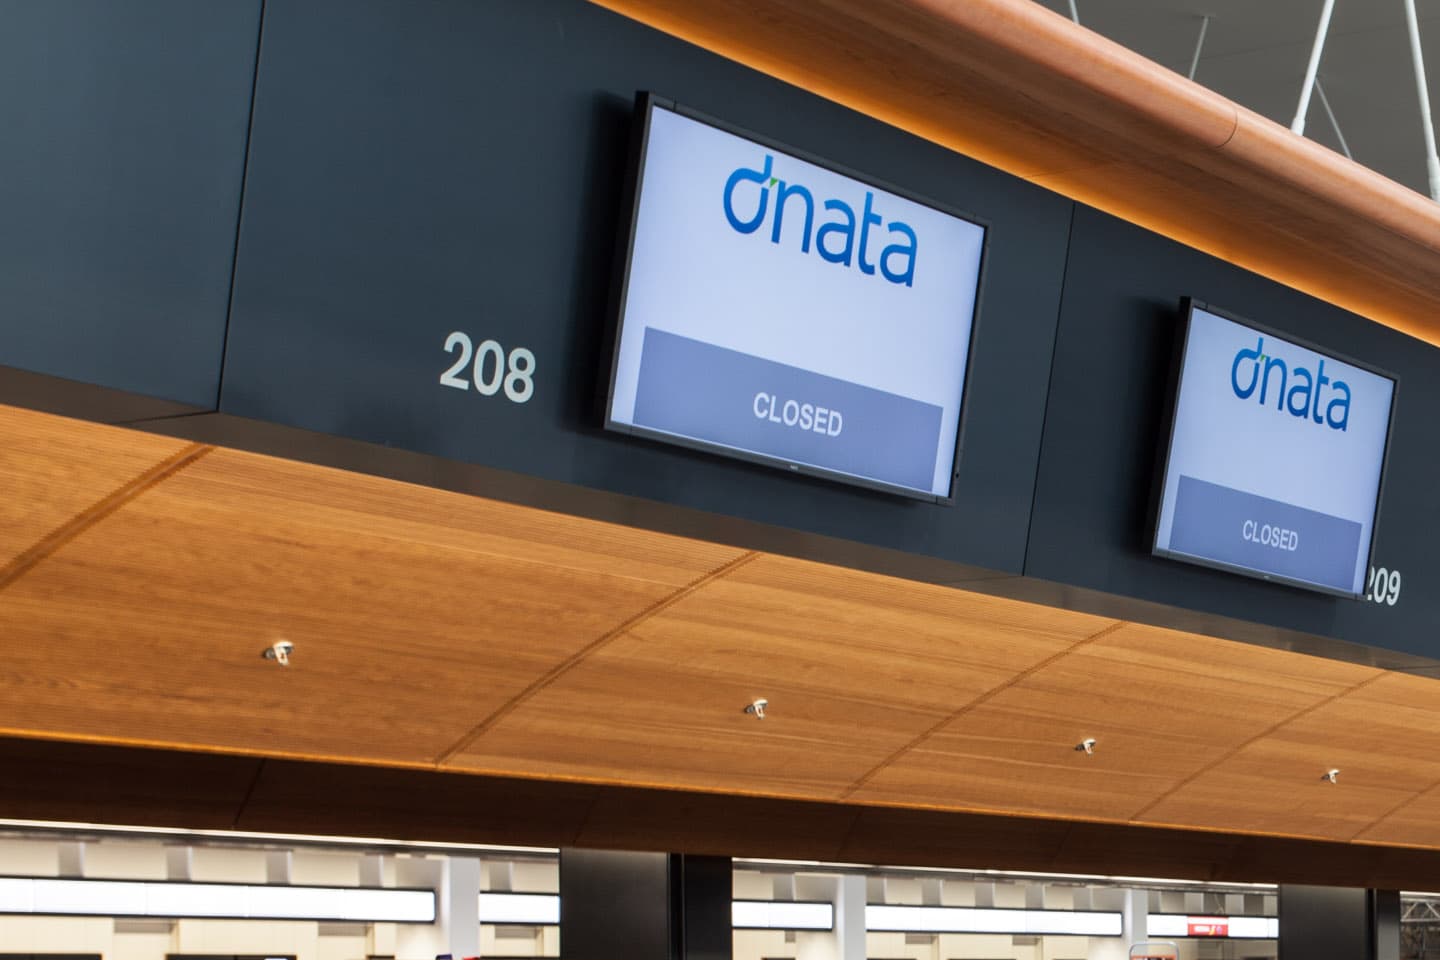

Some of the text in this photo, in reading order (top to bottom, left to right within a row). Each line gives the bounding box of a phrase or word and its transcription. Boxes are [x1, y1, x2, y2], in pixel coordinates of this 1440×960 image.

[723, 154, 918, 288] dnata
[439, 331, 536, 404] 208
[1231, 337, 1351, 432] dnata
[752, 391, 844, 438] CLOSED
[1242, 519, 1299, 552] CLOSED
